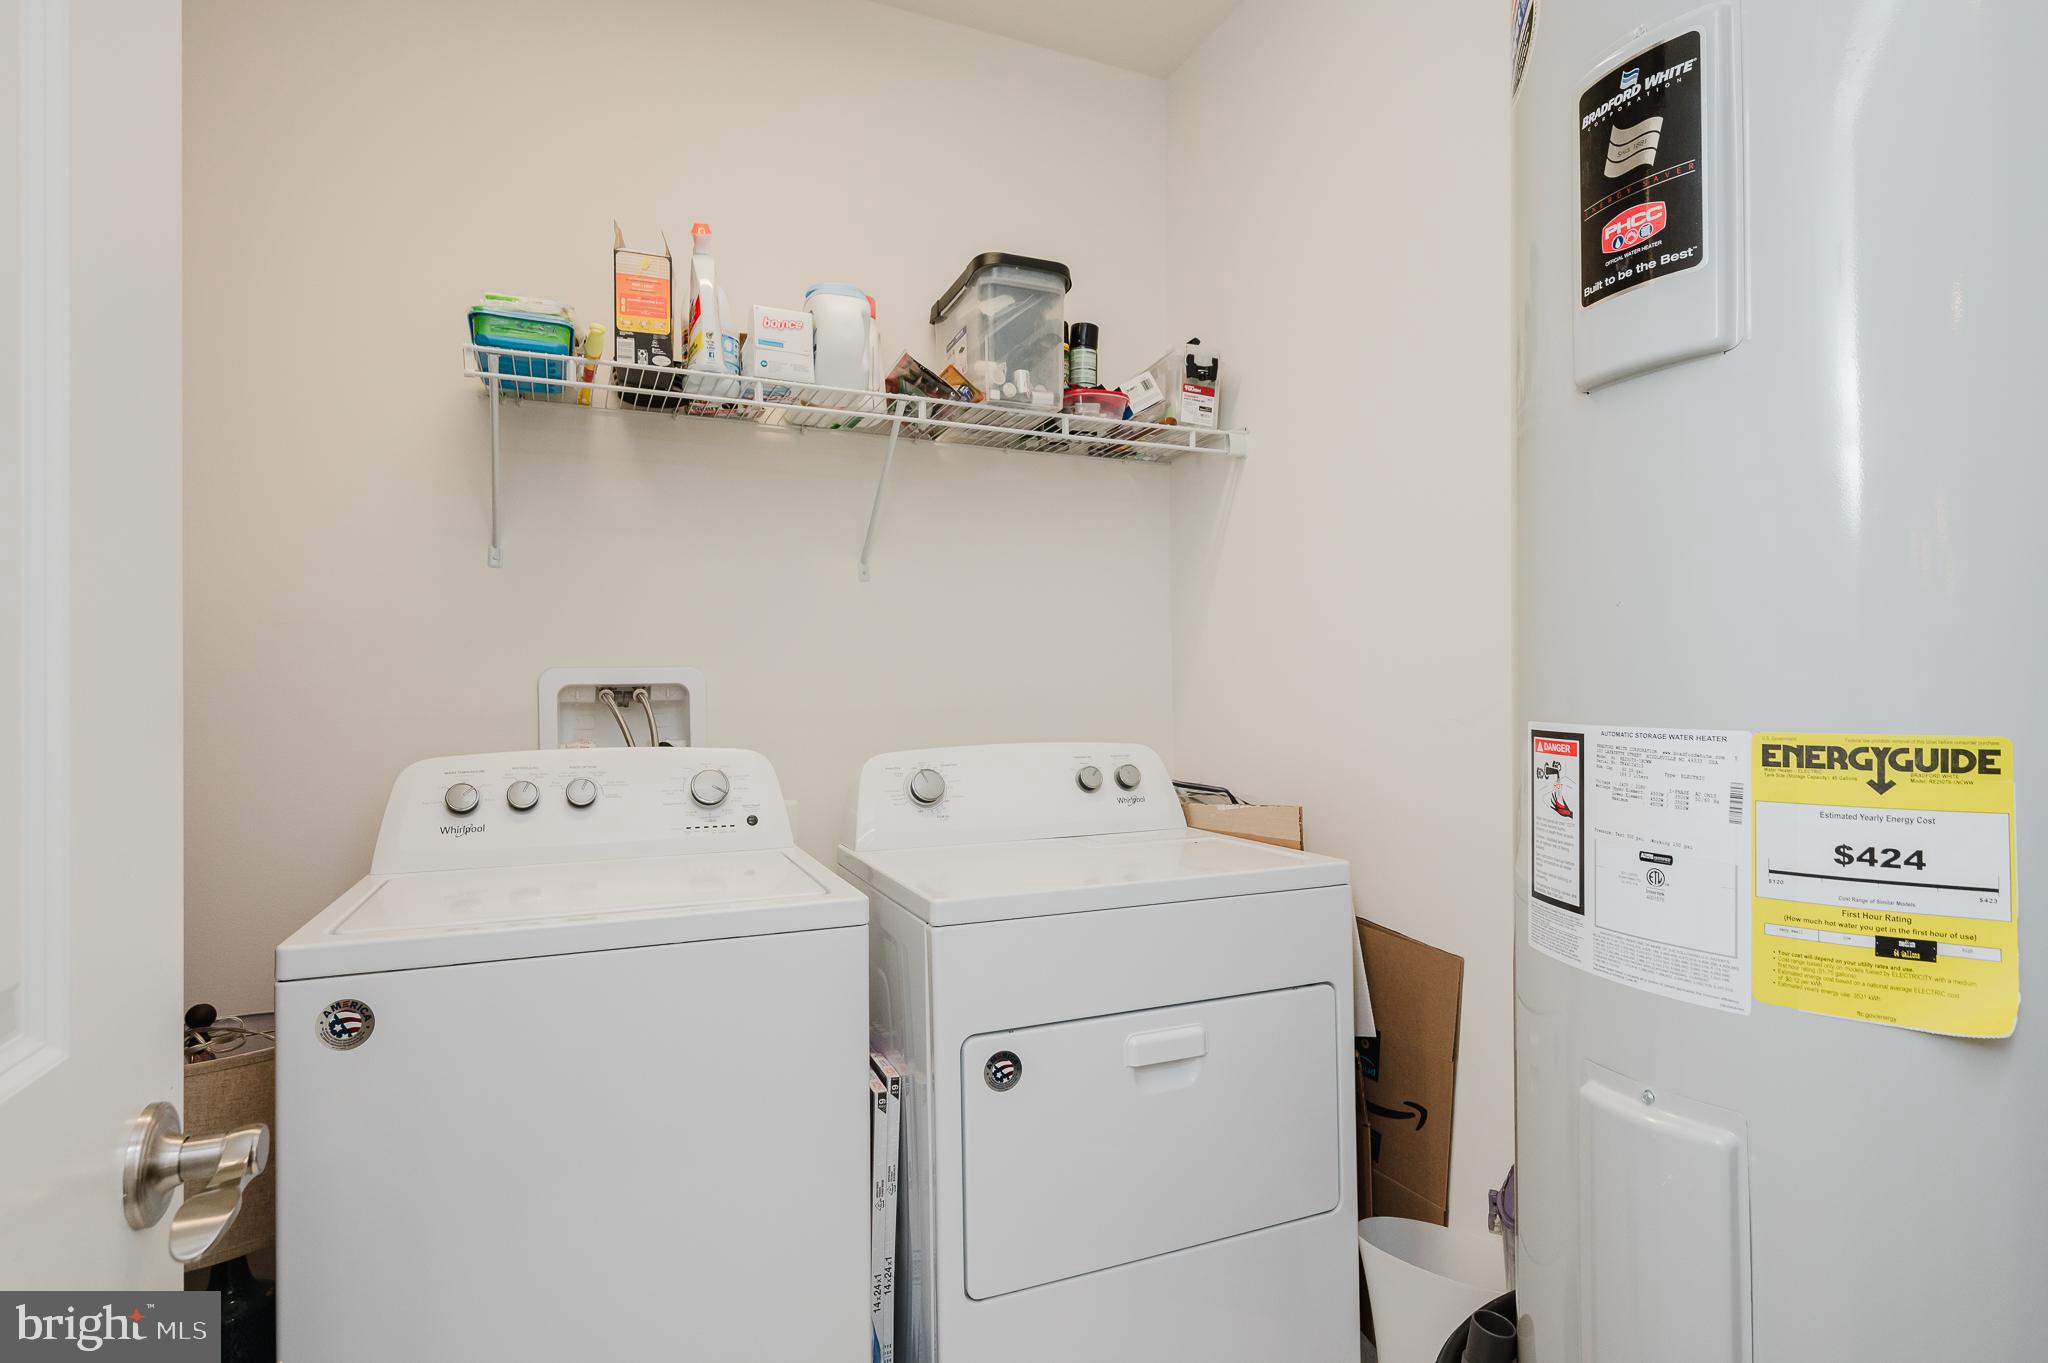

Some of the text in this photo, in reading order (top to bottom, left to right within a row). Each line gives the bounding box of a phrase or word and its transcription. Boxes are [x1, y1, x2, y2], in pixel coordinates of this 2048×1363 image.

[1582, 60, 1694, 130] BRADFORD WHITE
[1588, 78, 1682, 132] CORPORATION
[1584, 163, 1694, 216] ENERGY SAVER
[1605, 205, 1662, 240] PHCC
[1605, 240, 1662, 267] OFFICIAL WATER HEATER
[1584, 248, 1694, 297] Built to be the Best
[763, 316, 803, 331] bounce
[1543, 743, 1571, 753] DANGER
[1762, 744, 2001, 779] ENERGYGUIDE
[1117, 795, 1146, 806] Whirlpool
[1820, 811, 1857, 820] Estimated
[1860, 814, 1883, 824] Yearly
[1886, 815, 1914, 825] Energy
[440, 824, 485, 838] Whirlpool
[1834, 844, 1926, 870] $424
[1842, 910, 1912, 925] First Hour Rating
[1930, 930, 1948, 938] hour
[323, 1000, 372, 1022] AMERICA
